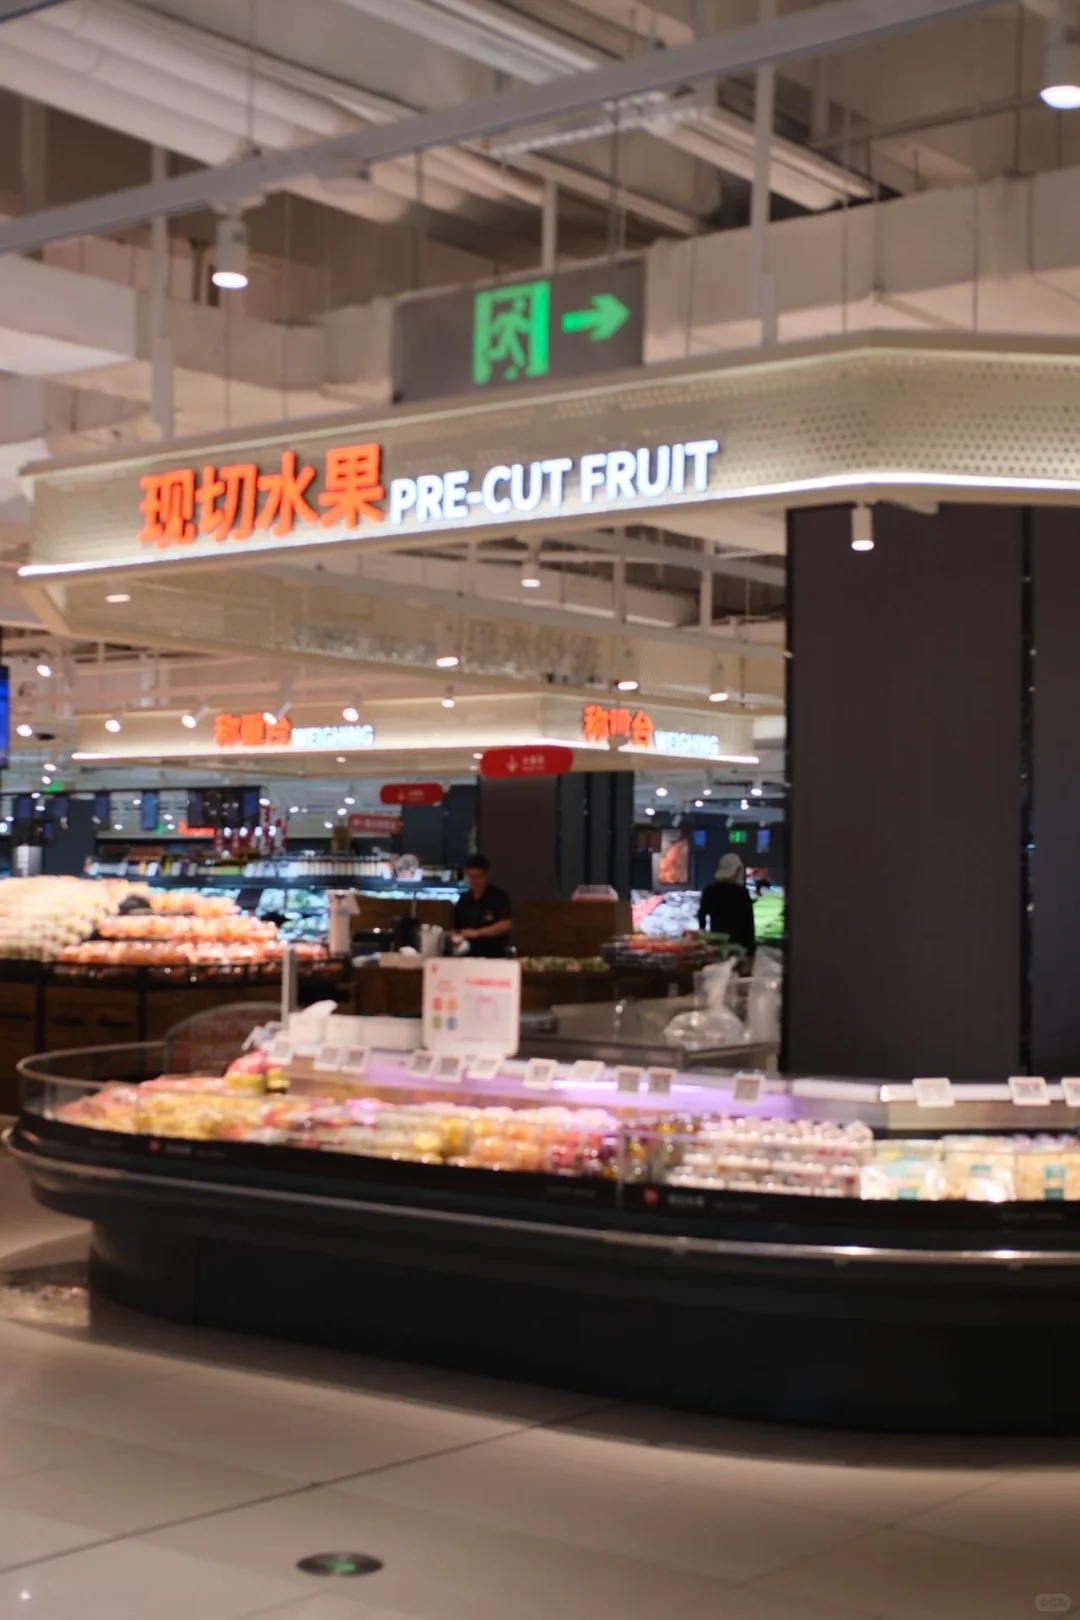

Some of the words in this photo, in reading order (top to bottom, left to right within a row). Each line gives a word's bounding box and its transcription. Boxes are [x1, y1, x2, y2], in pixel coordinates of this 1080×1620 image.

[138, 442, 384, 548] 现切水果
[389, 457, 572, 525] PRE-CUT
[578, 438, 719, 504] FRUIT
